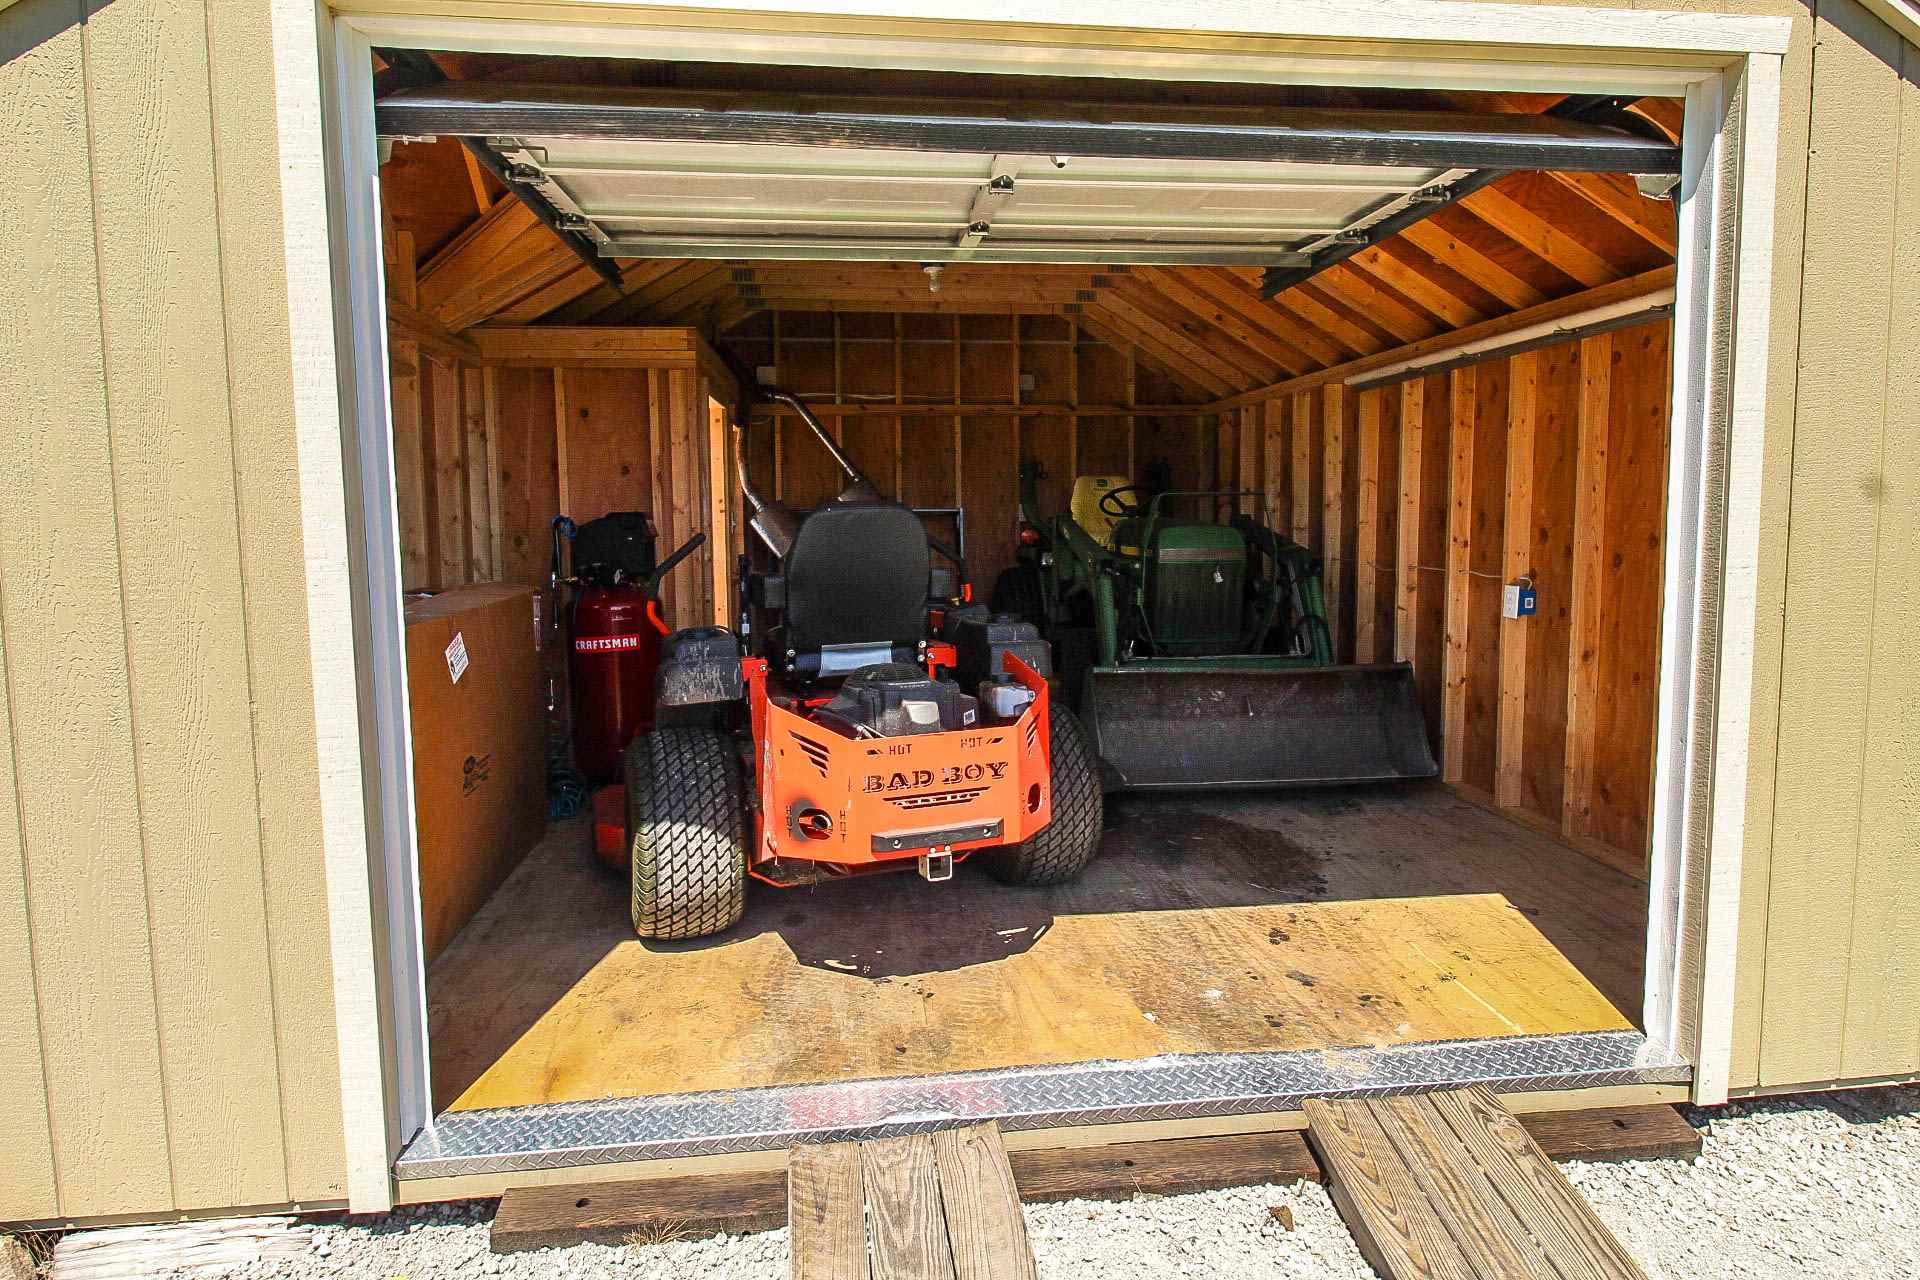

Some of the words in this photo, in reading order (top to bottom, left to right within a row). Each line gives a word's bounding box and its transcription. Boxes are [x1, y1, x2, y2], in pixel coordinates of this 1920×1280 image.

[575, 637, 638, 650] CRAFTSMAN
[960, 736, 983, 748] HOT
[889, 743, 913, 755] HOT
[863, 769, 934, 793] BAD
[942, 761, 1009, 784] BOY
